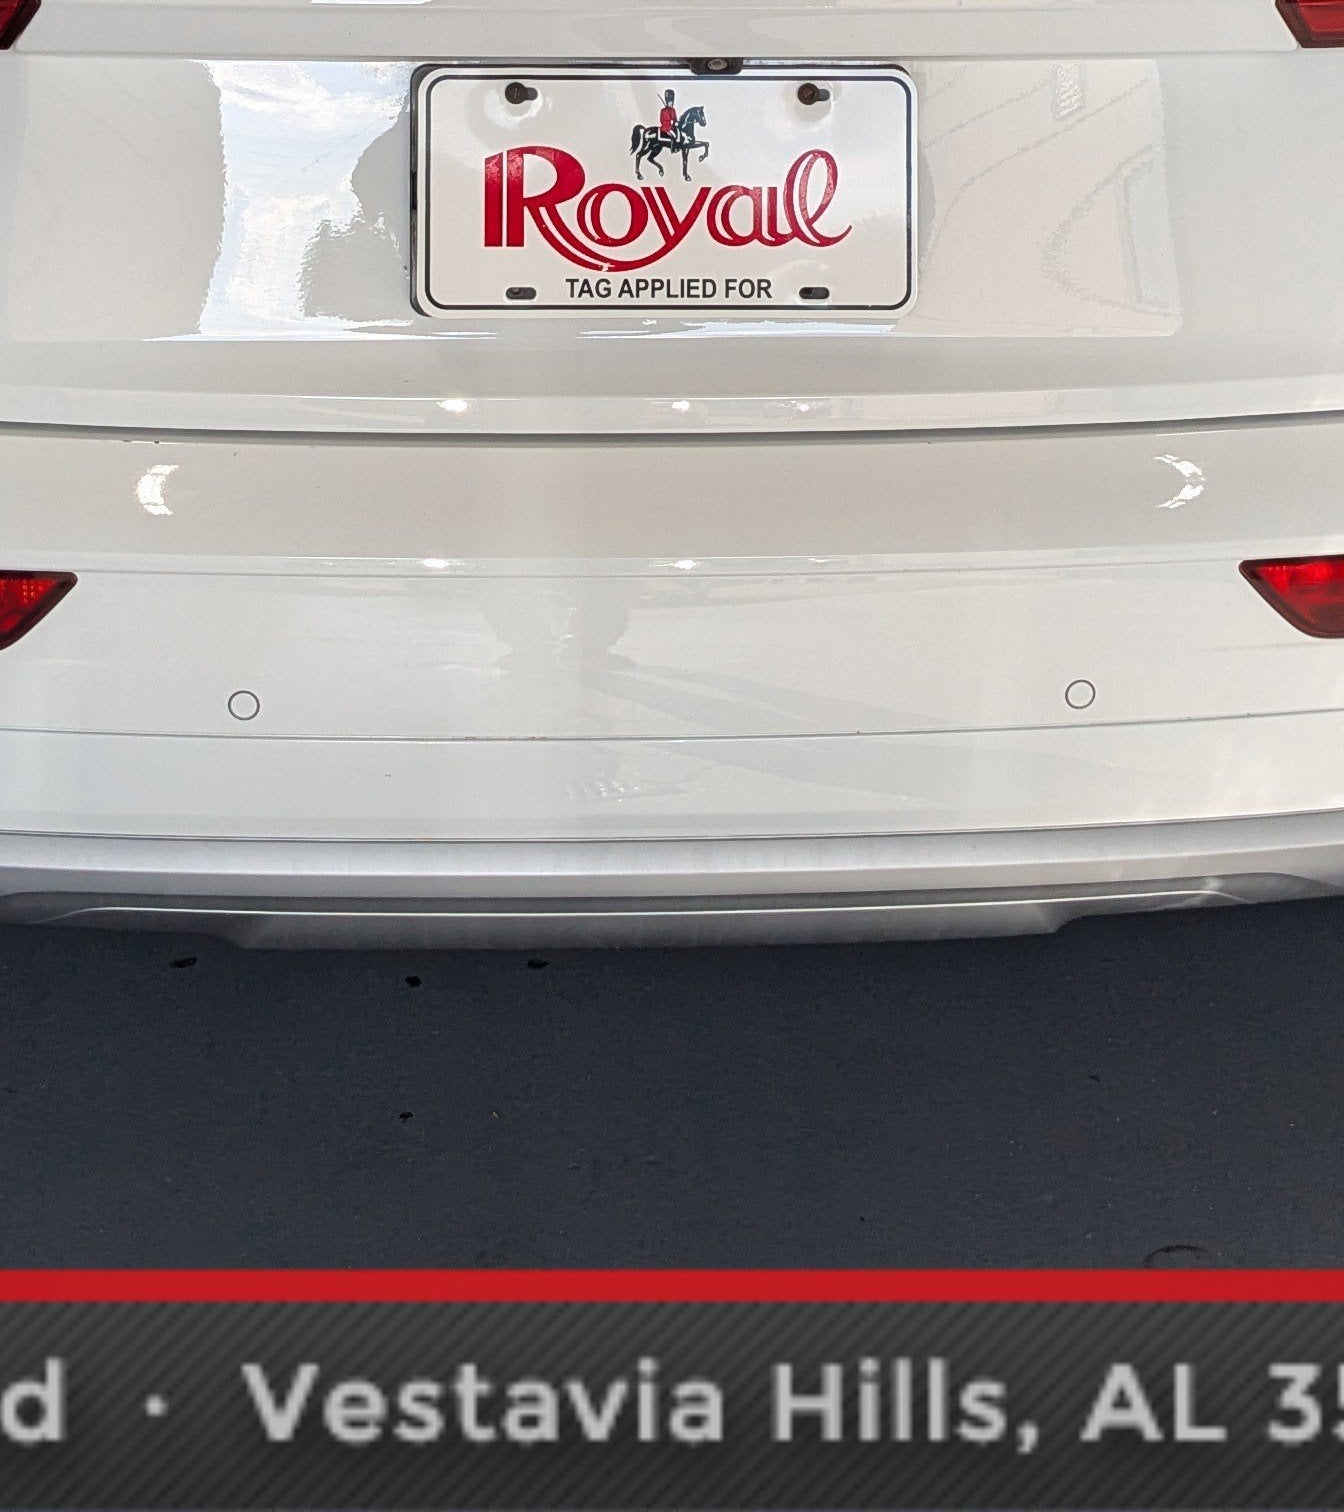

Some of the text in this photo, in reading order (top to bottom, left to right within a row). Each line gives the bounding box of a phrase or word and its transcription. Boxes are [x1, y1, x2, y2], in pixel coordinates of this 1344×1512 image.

[483, 145, 854, 272] Royal
[565, 278, 773, 299] TAG APPLIED FOR
